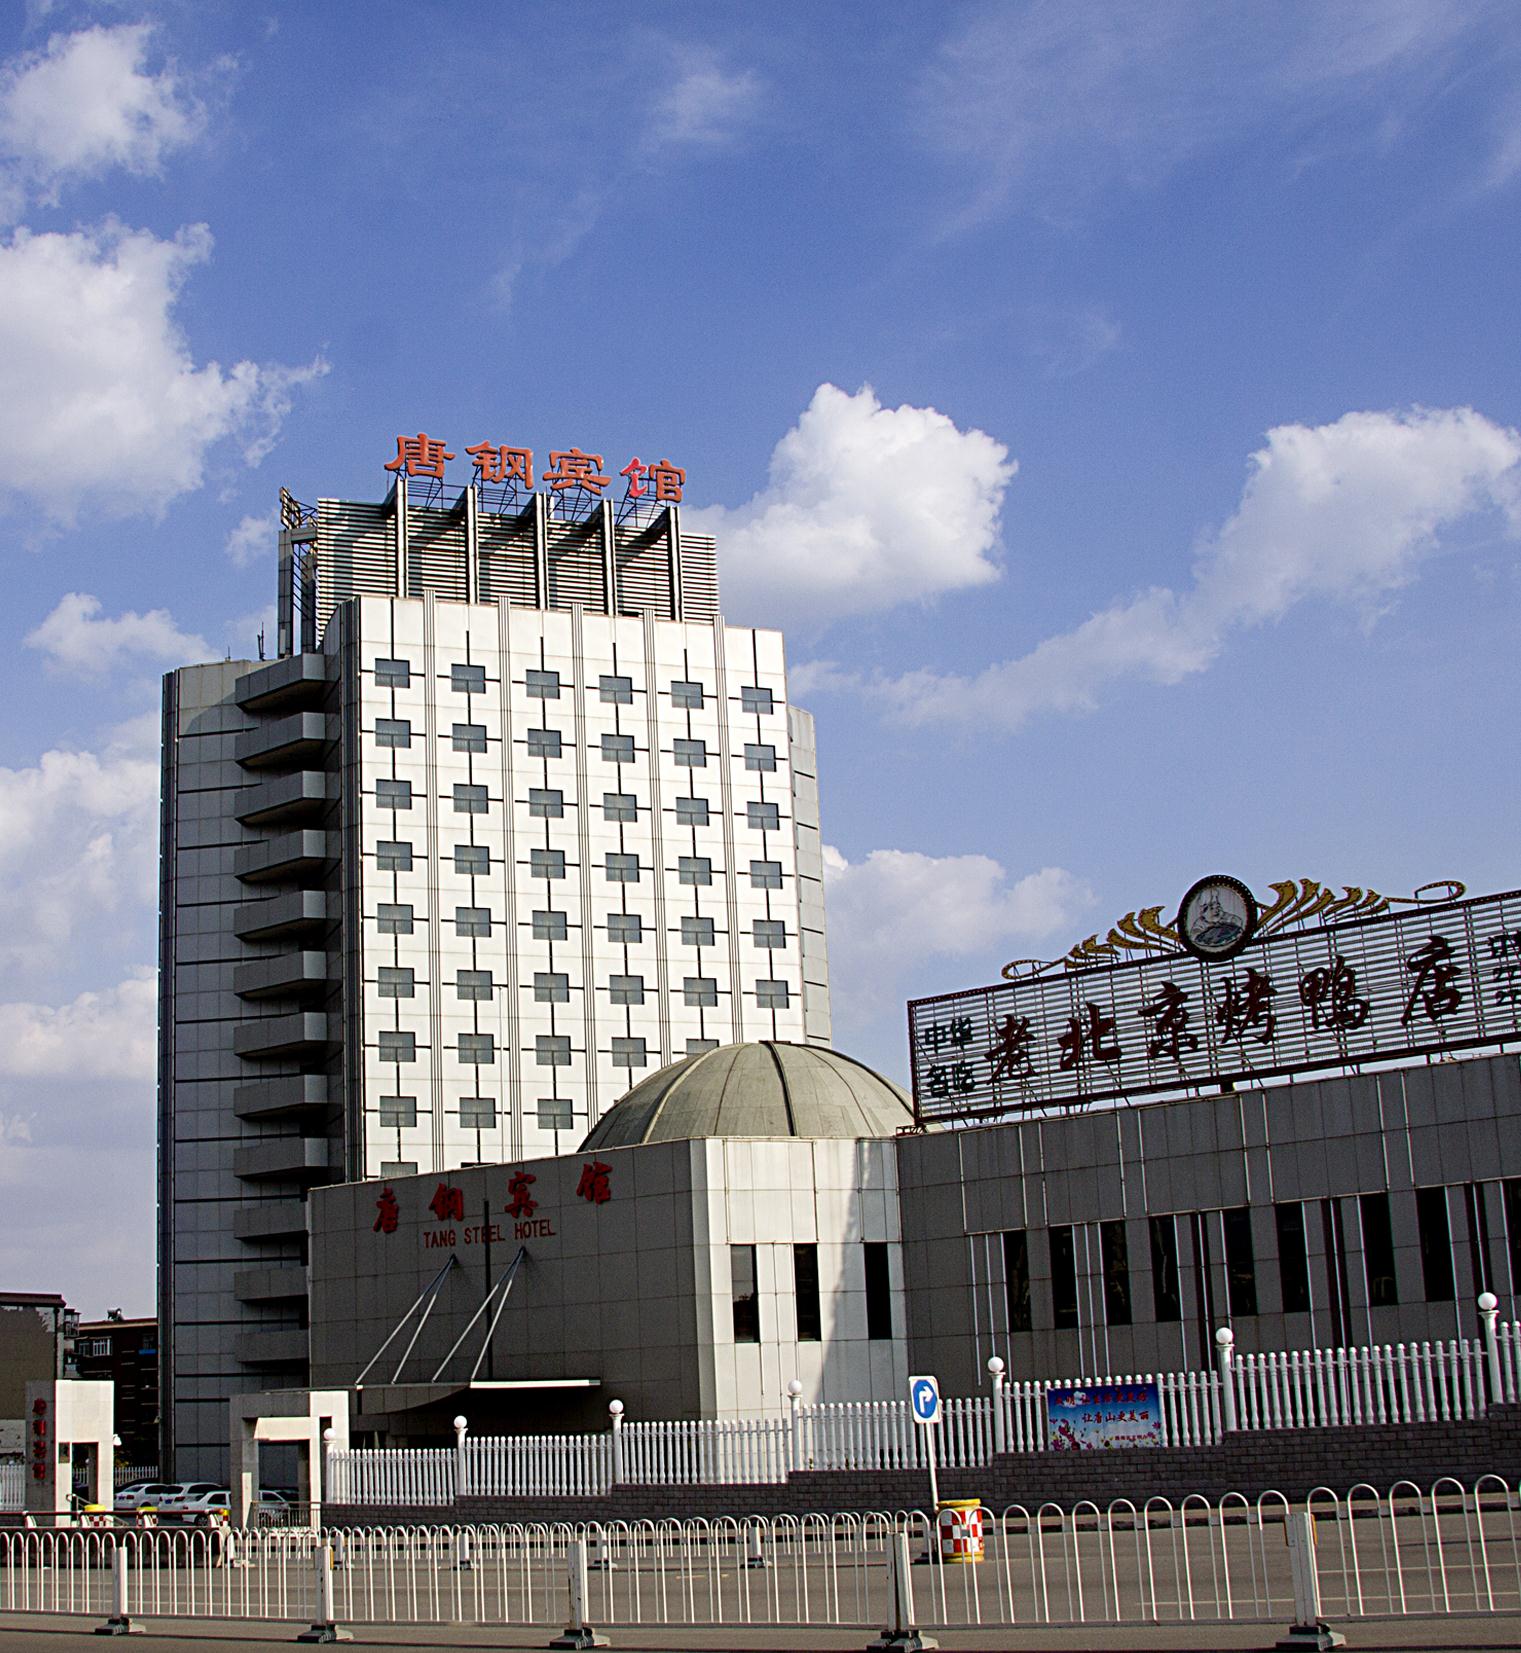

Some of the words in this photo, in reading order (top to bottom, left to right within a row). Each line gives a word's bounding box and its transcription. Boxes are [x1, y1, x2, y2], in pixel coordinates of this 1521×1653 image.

[384, 432, 686, 502] 唐钢宾馆
[424, 1229, 456, 1249] TANG
[514, 1218, 557, 1241] HOTEL
